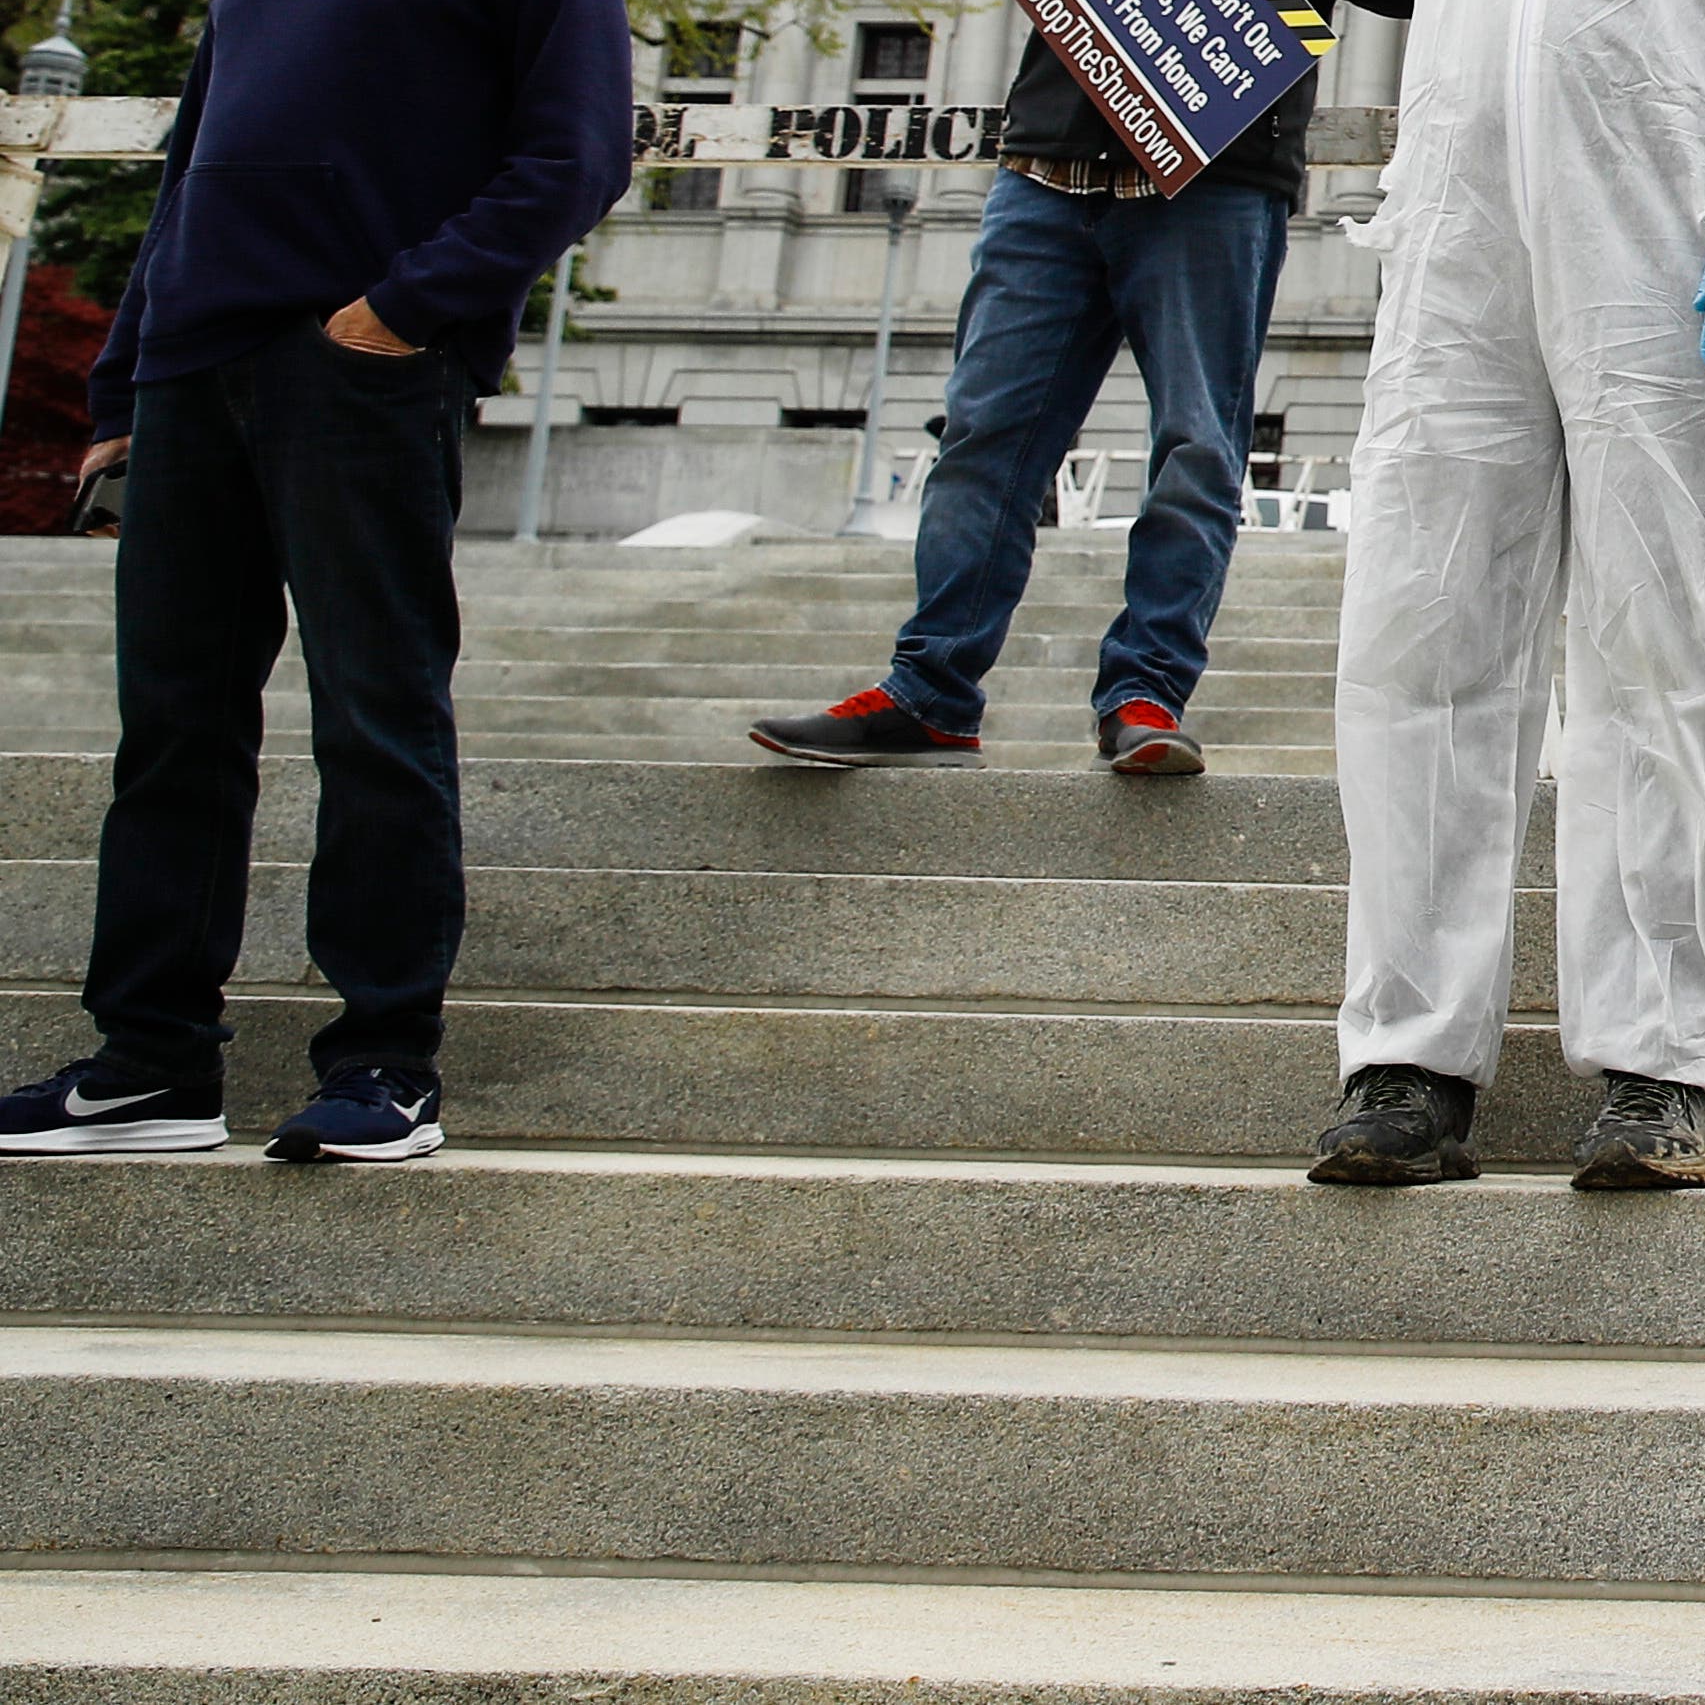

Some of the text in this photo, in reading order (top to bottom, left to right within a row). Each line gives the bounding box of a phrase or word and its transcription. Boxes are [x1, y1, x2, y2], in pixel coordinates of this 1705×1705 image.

[1174, 0, 1207, 45] We
[1201, 29, 1256, 100] Can't
[1244, 16, 1283, 67] Our
[1155, 47, 1209, 114] Home
